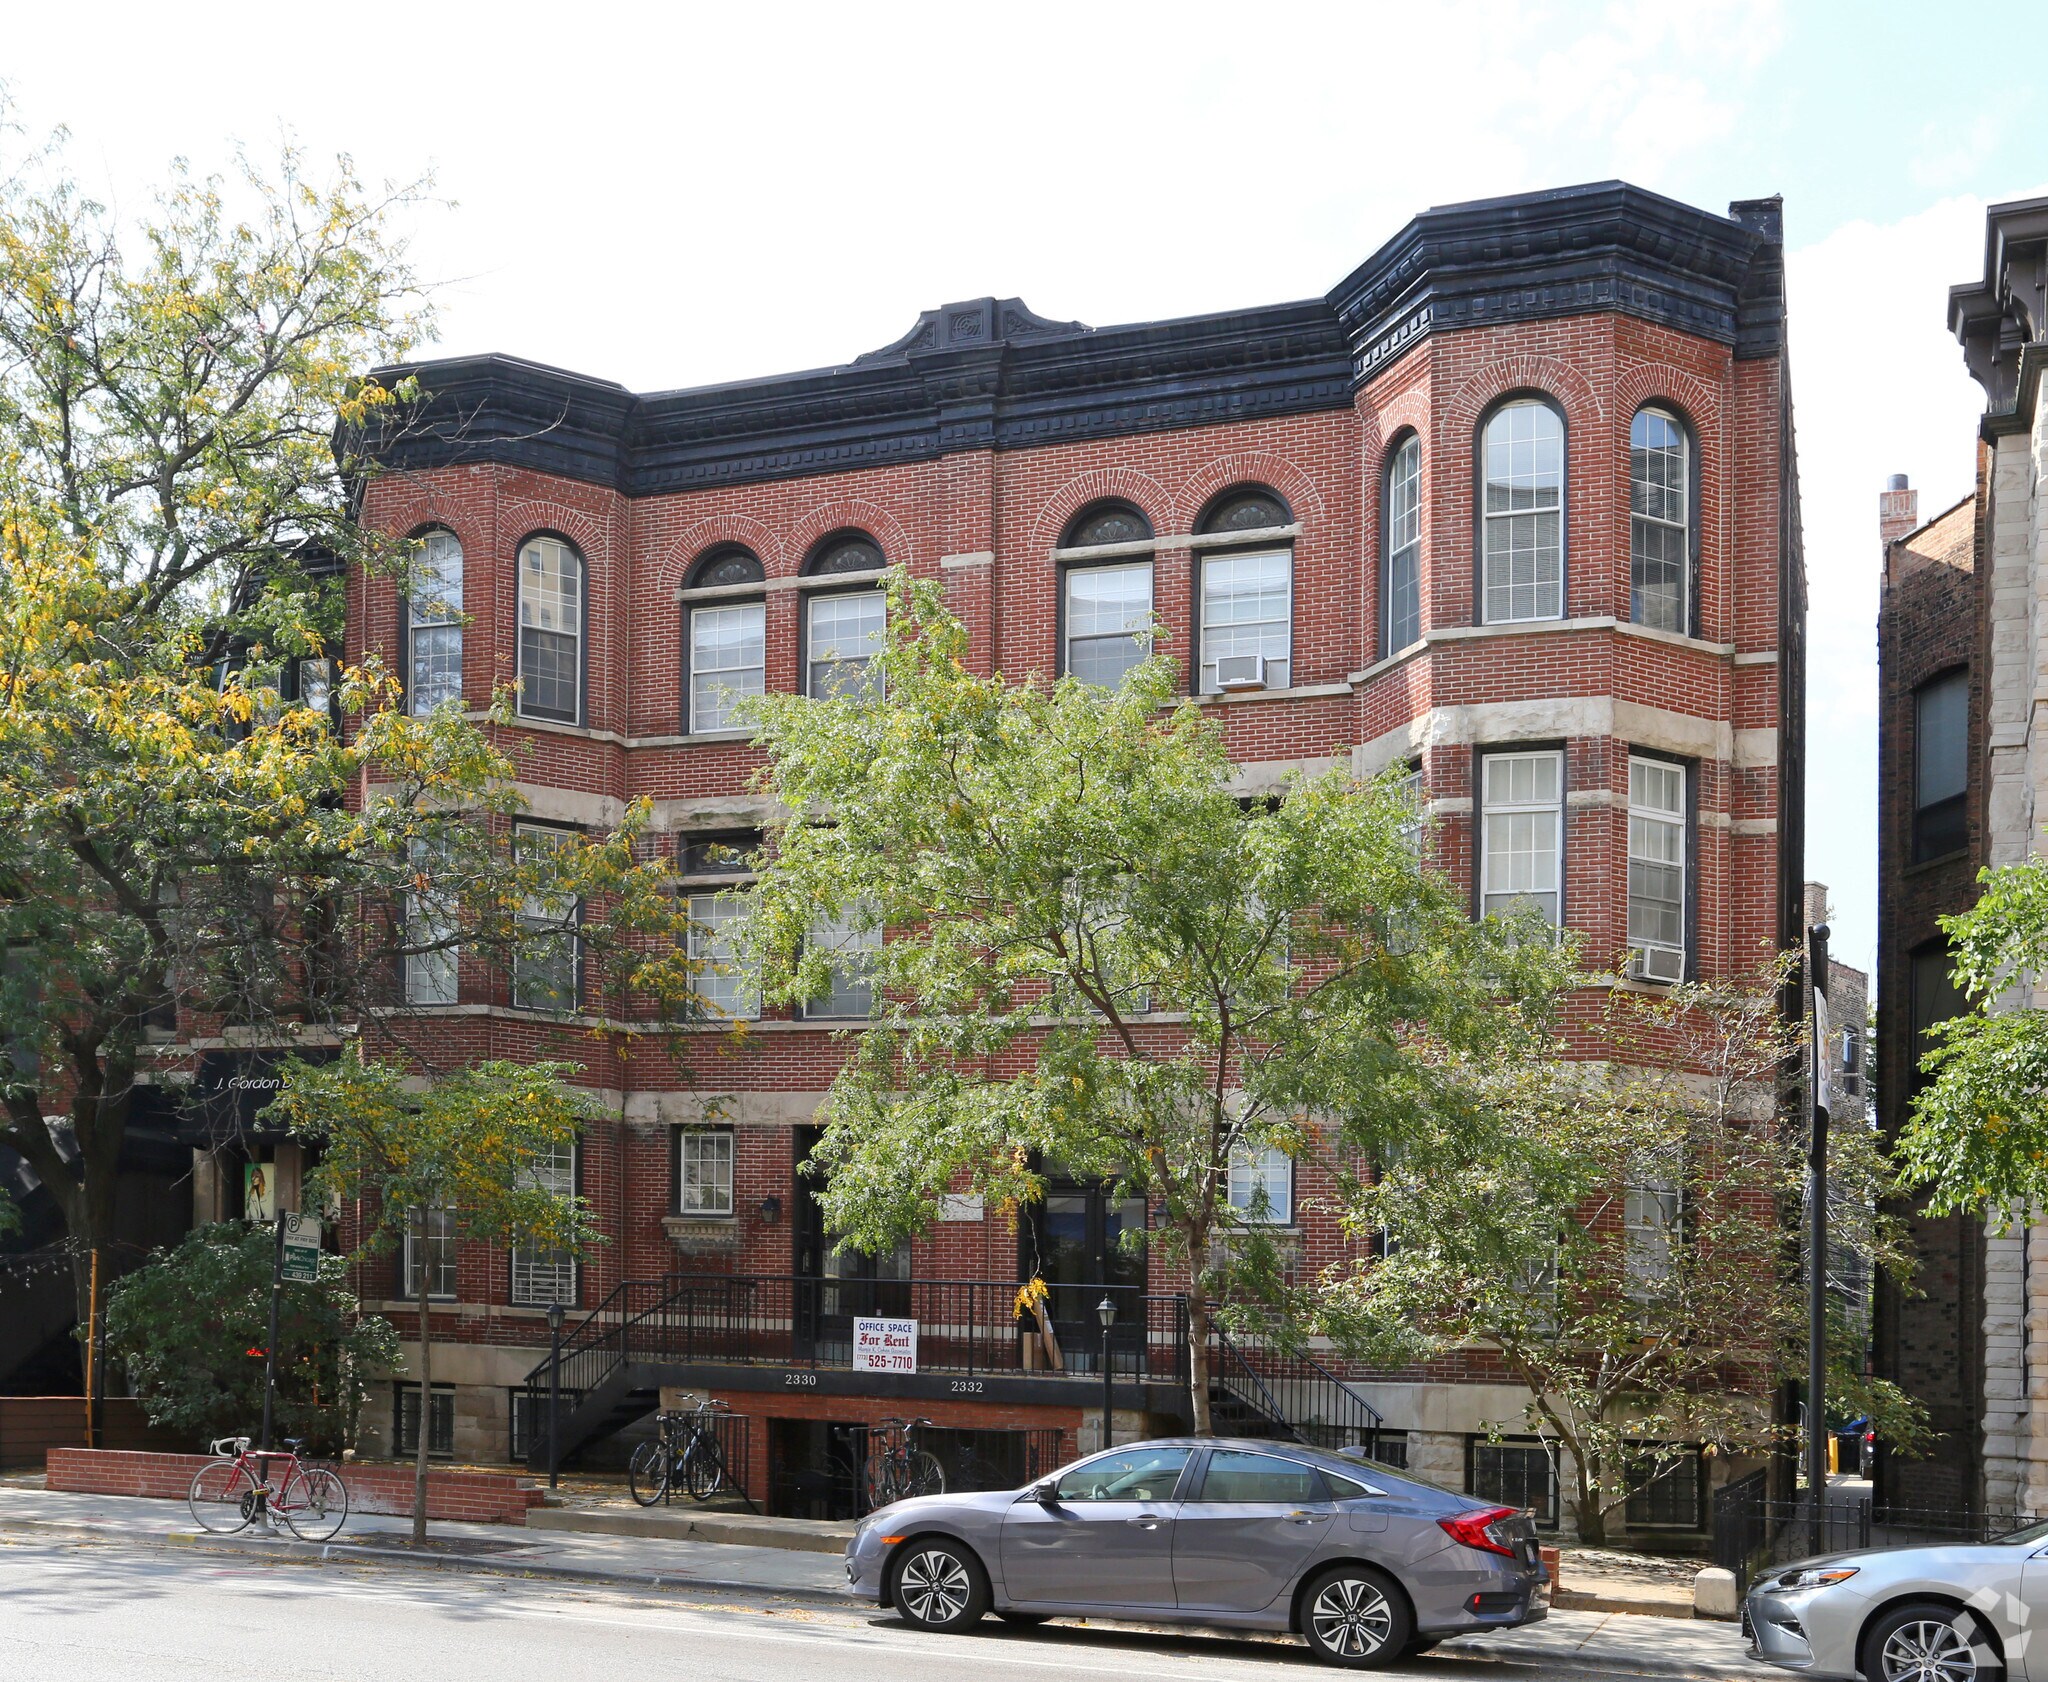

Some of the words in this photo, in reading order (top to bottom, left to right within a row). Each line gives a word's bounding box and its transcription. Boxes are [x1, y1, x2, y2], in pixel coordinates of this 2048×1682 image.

[214, 1077, 223, 1090] J.
[228, 1076, 280, 1089] Gordon
[859, 1322, 884, 1331] OFFICE
[888, 1324, 912, 1332] SPACE
[859, 1333, 880, 1345] For
[883, 1334, 909, 1347] Rent
[869, 1355, 912, 1369] 525-7710
[785, 1374, 816, 1386] 2330
[952, 1381, 983, 1393] 2332
